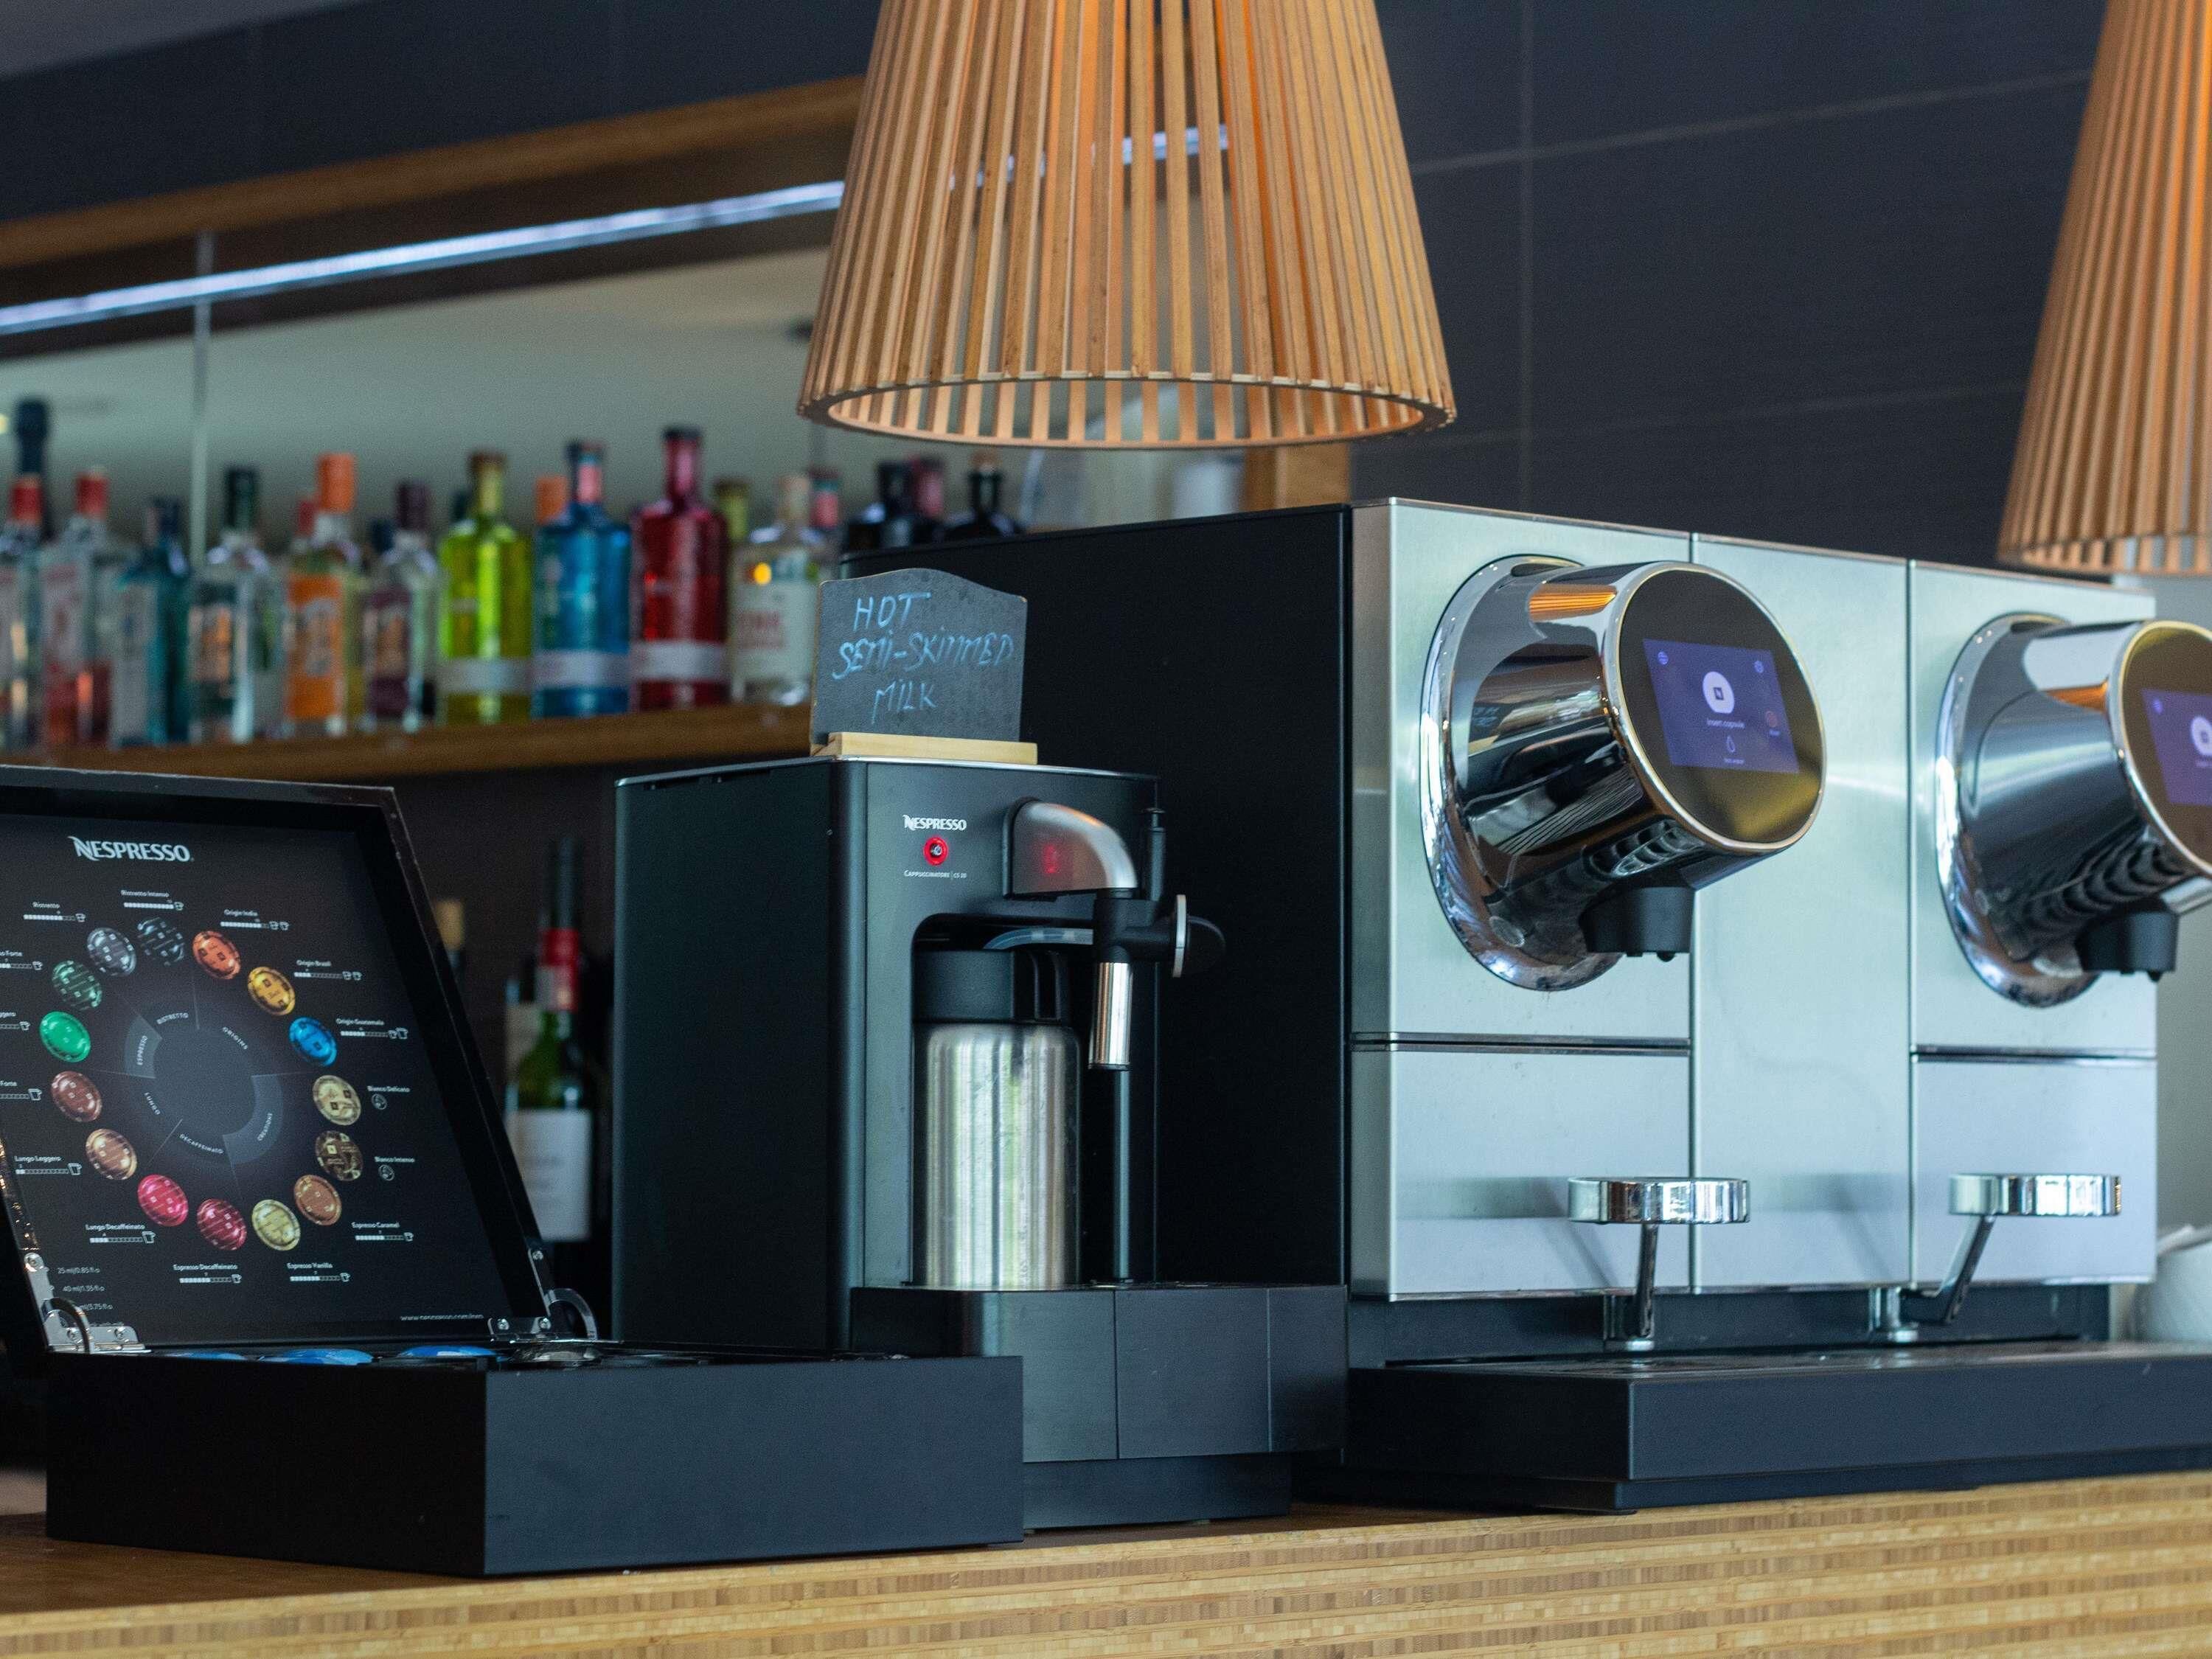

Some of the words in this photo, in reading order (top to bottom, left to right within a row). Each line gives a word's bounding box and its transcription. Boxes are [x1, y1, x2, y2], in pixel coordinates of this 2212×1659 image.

[852, 592, 932, 632] HOT
[902, 814, 967, 832] NESPRESSO
[67, 835, 192, 863] NESPRESSO
